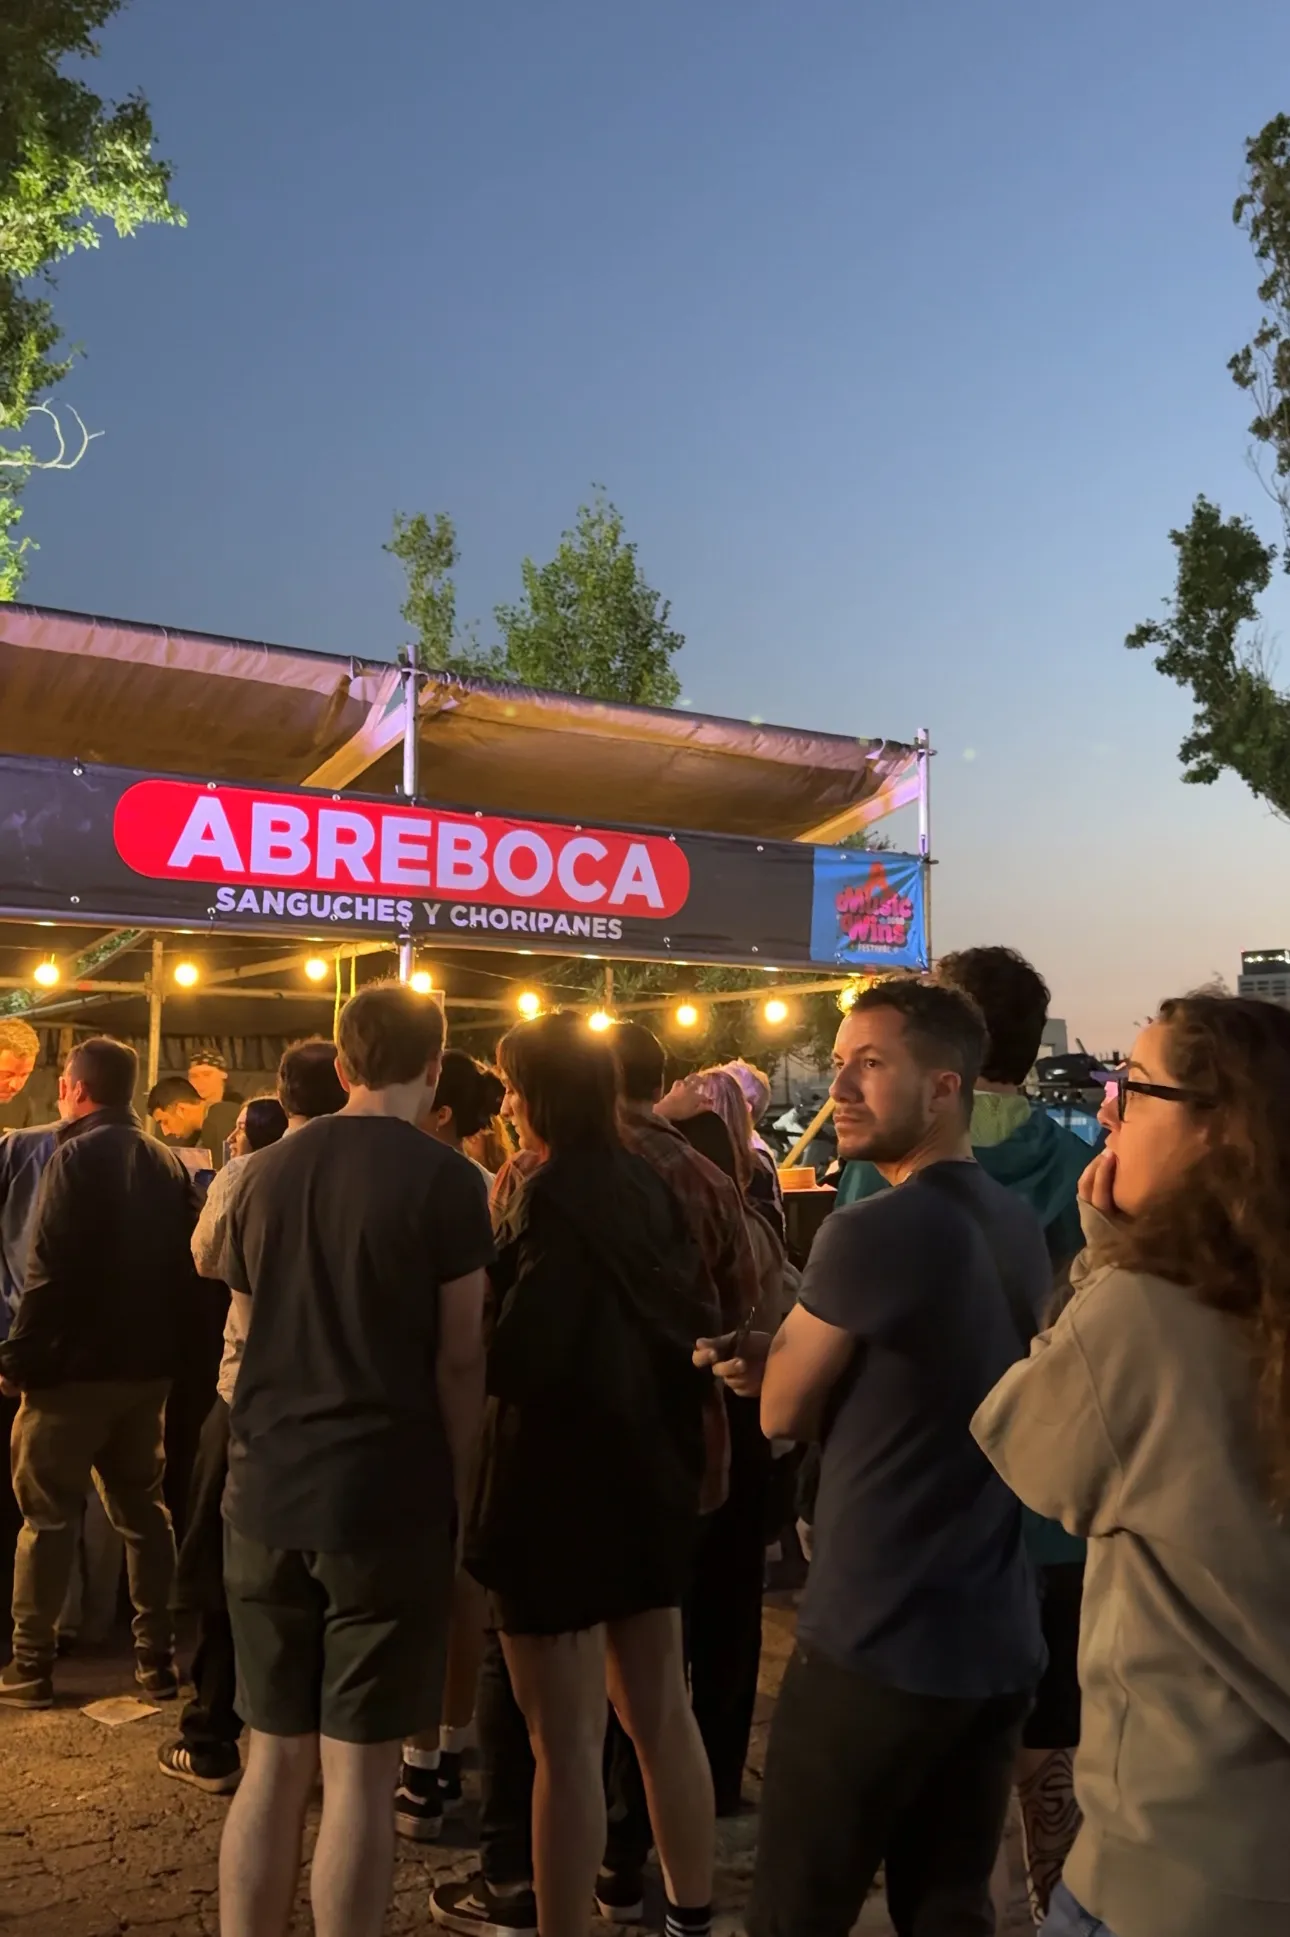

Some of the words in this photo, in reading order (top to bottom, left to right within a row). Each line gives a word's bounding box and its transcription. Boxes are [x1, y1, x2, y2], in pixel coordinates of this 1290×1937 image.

[167, 796, 665, 909] ABREBOCA
[215, 886, 414, 924] SANGUCHES
[422, 903, 441, 925] Y
[450, 905, 623, 940] CHORIPANES
[836, 886, 912, 918] Music
[840, 913, 905, 944] Wins
